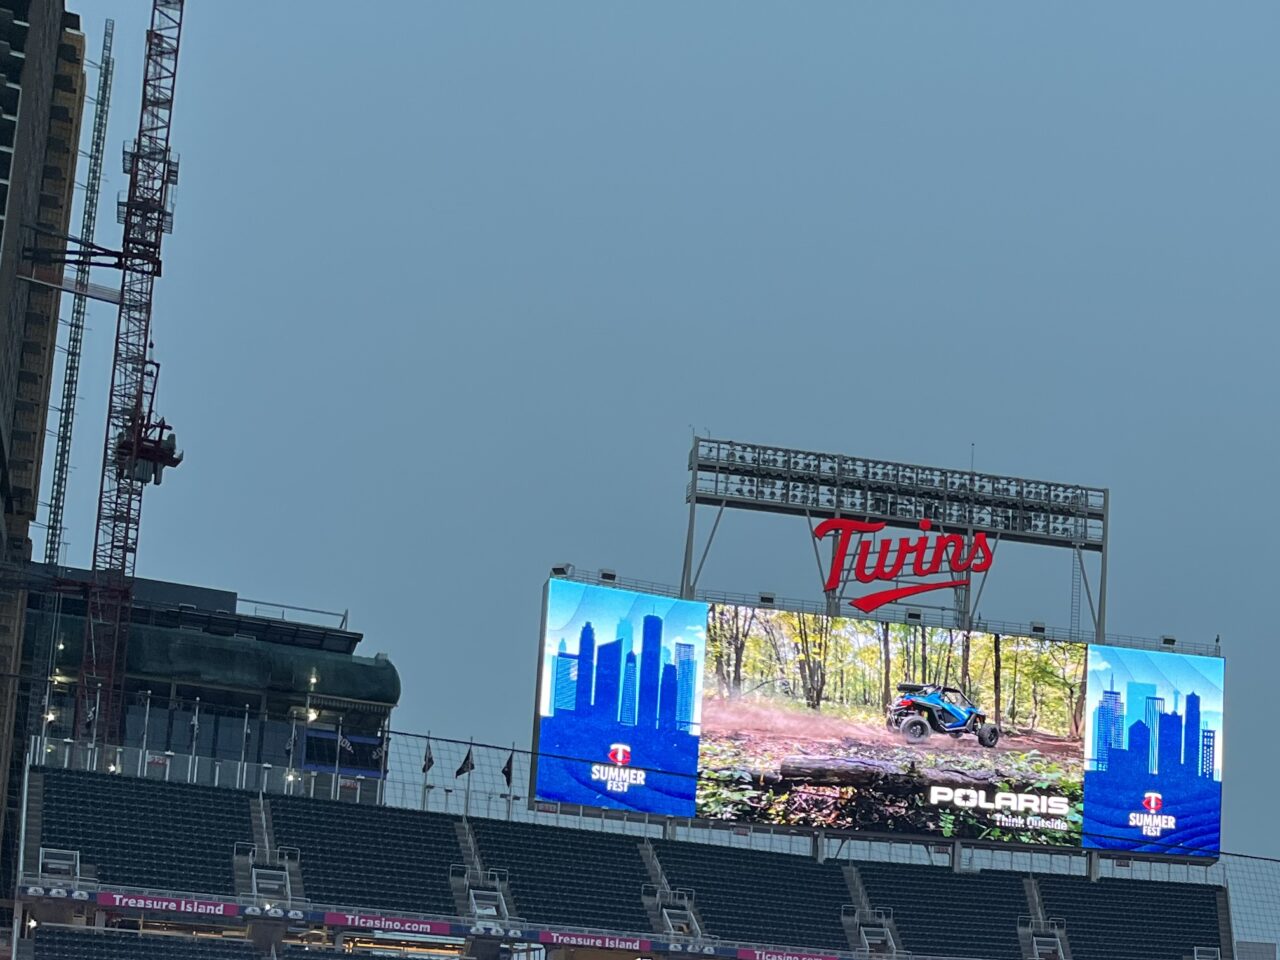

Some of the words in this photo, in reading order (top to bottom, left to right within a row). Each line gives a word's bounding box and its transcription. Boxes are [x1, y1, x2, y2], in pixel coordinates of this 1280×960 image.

[813, 518, 994, 593] Twins
[591, 764, 646, 785] SUMMER
[607, 780, 629, 792] FEST
[929, 785, 1070, 815] POLARIS
[994, 813, 1025, 828] Think
[1026, 815, 1068, 831] Outside
[1129, 812, 1176, 829] SUMMER
[1142, 825, 1162, 837] FEST
[113, 894, 177, 911] Treasure
[179, 900, 224, 915] Island
[551, 933, 603, 947] Treasure
[605, 937, 640, 950] Island
